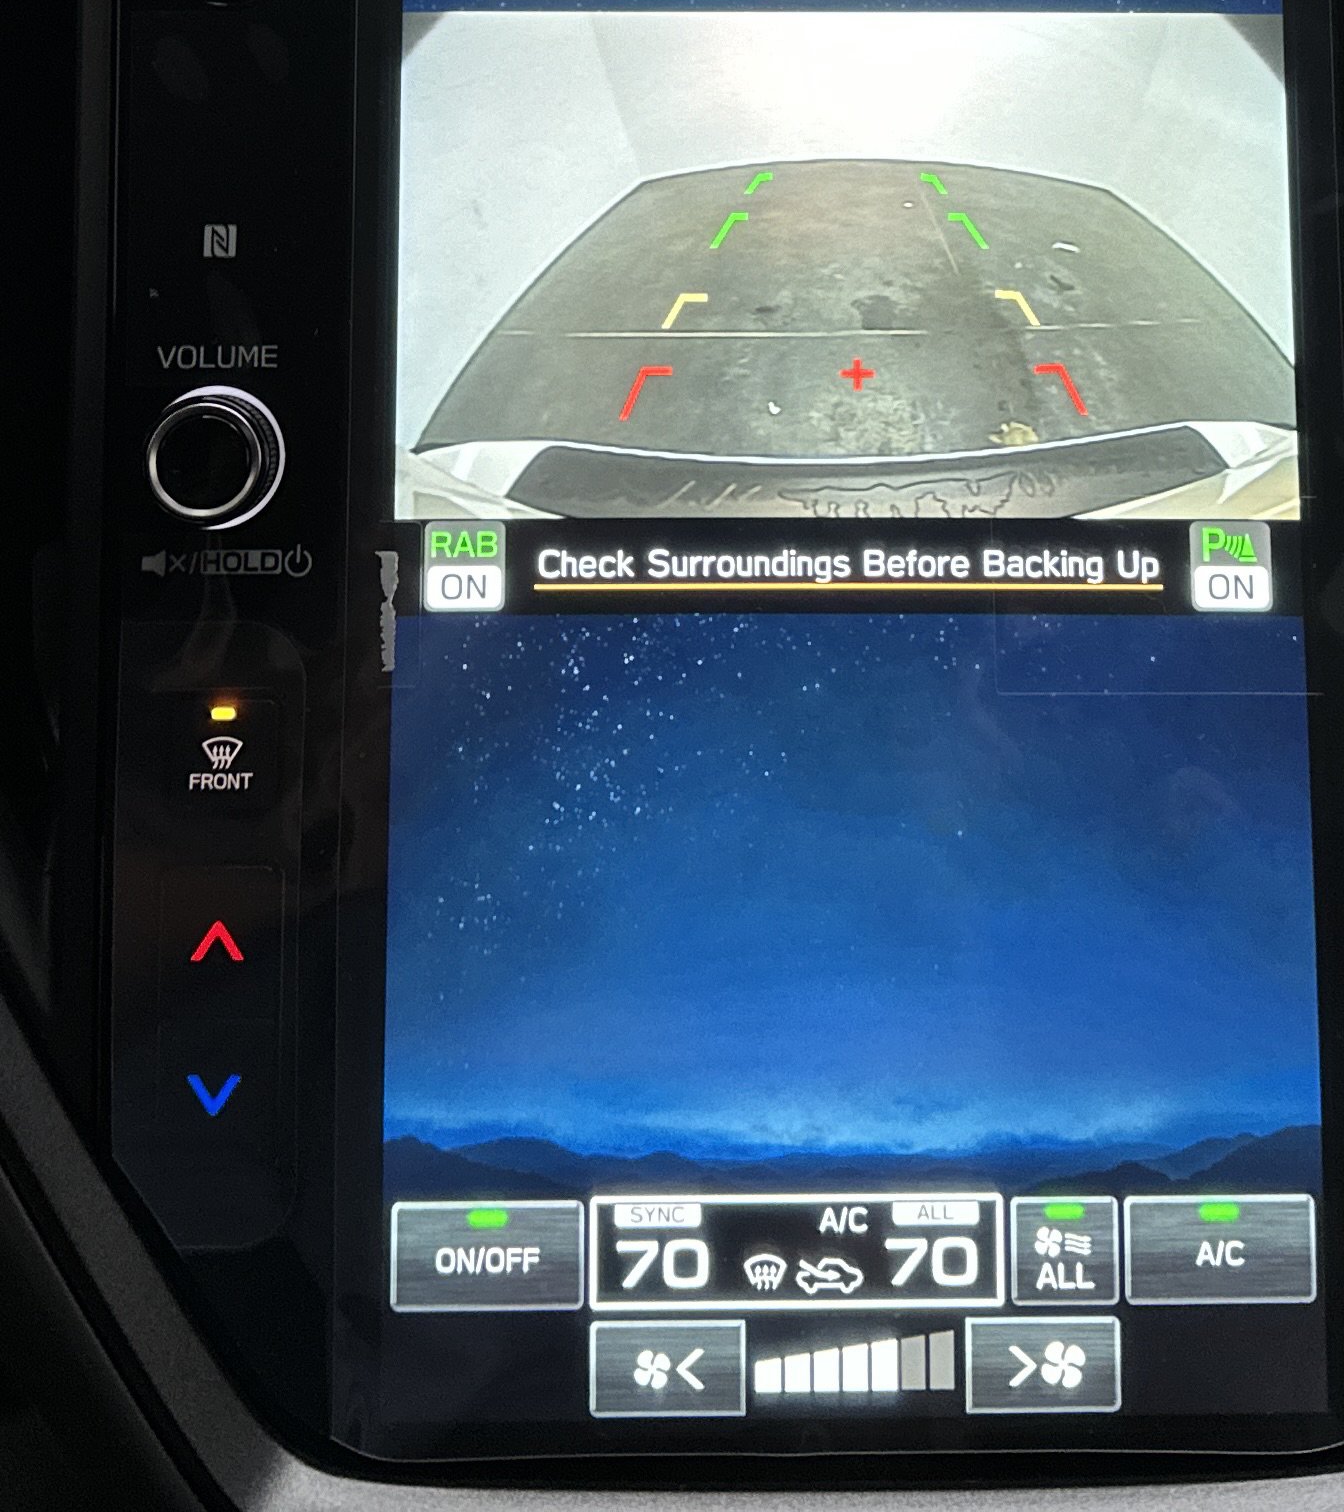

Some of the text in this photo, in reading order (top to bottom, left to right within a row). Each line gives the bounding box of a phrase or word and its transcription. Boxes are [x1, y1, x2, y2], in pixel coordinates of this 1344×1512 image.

[157, 345, 278, 369] VOLUME
[430, 529, 499, 558] RAB
[203, 551, 279, 572] HOLD
[537, 548, 1160, 584] Check Surroundings Before Backing Up
[441, 574, 487, 600] ON
[1208, 574, 1254, 600] ON
[188, 772, 254, 791] FRONT
[629, 1206, 686, 1224] SYNC
[818, 1206, 870, 1236] A/C
[916, 1204, 954, 1221] ALL
[434, 1245, 541, 1275] ON/OFF
[615, 1238, 710, 1290] 70
[884, 1235, 979, 1287] 70
[1195, 1239, 1246, 1267] A/C
[1036, 1261, 1096, 1291] ALL
